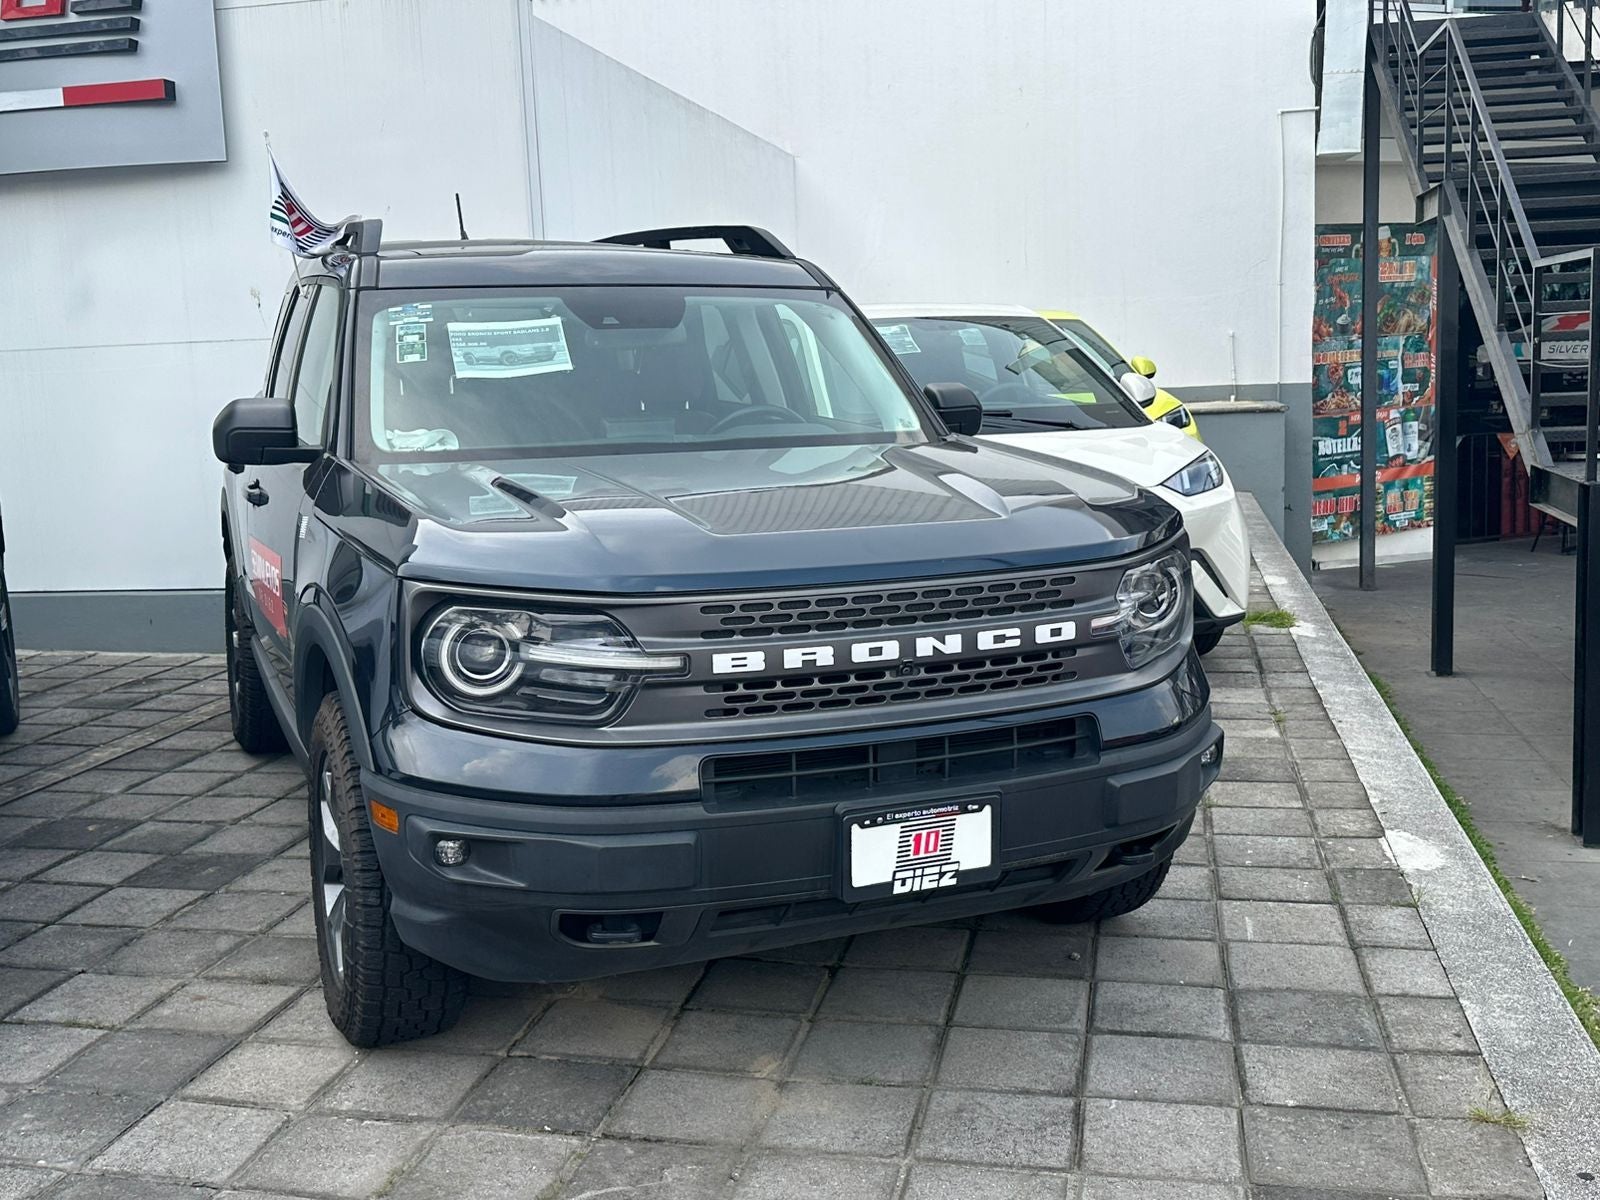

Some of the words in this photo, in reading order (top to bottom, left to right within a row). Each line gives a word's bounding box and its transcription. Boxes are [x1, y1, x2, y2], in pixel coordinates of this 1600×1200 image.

[1548, 344, 1589, 354] SILVER
[712, 621, 1077, 674] BRONCO
[895, 809, 922, 819] experto
[922, 804, 960, 815] automotriz
[912, 829, 941, 857] 10
[892, 861, 960, 895] DIEZ
